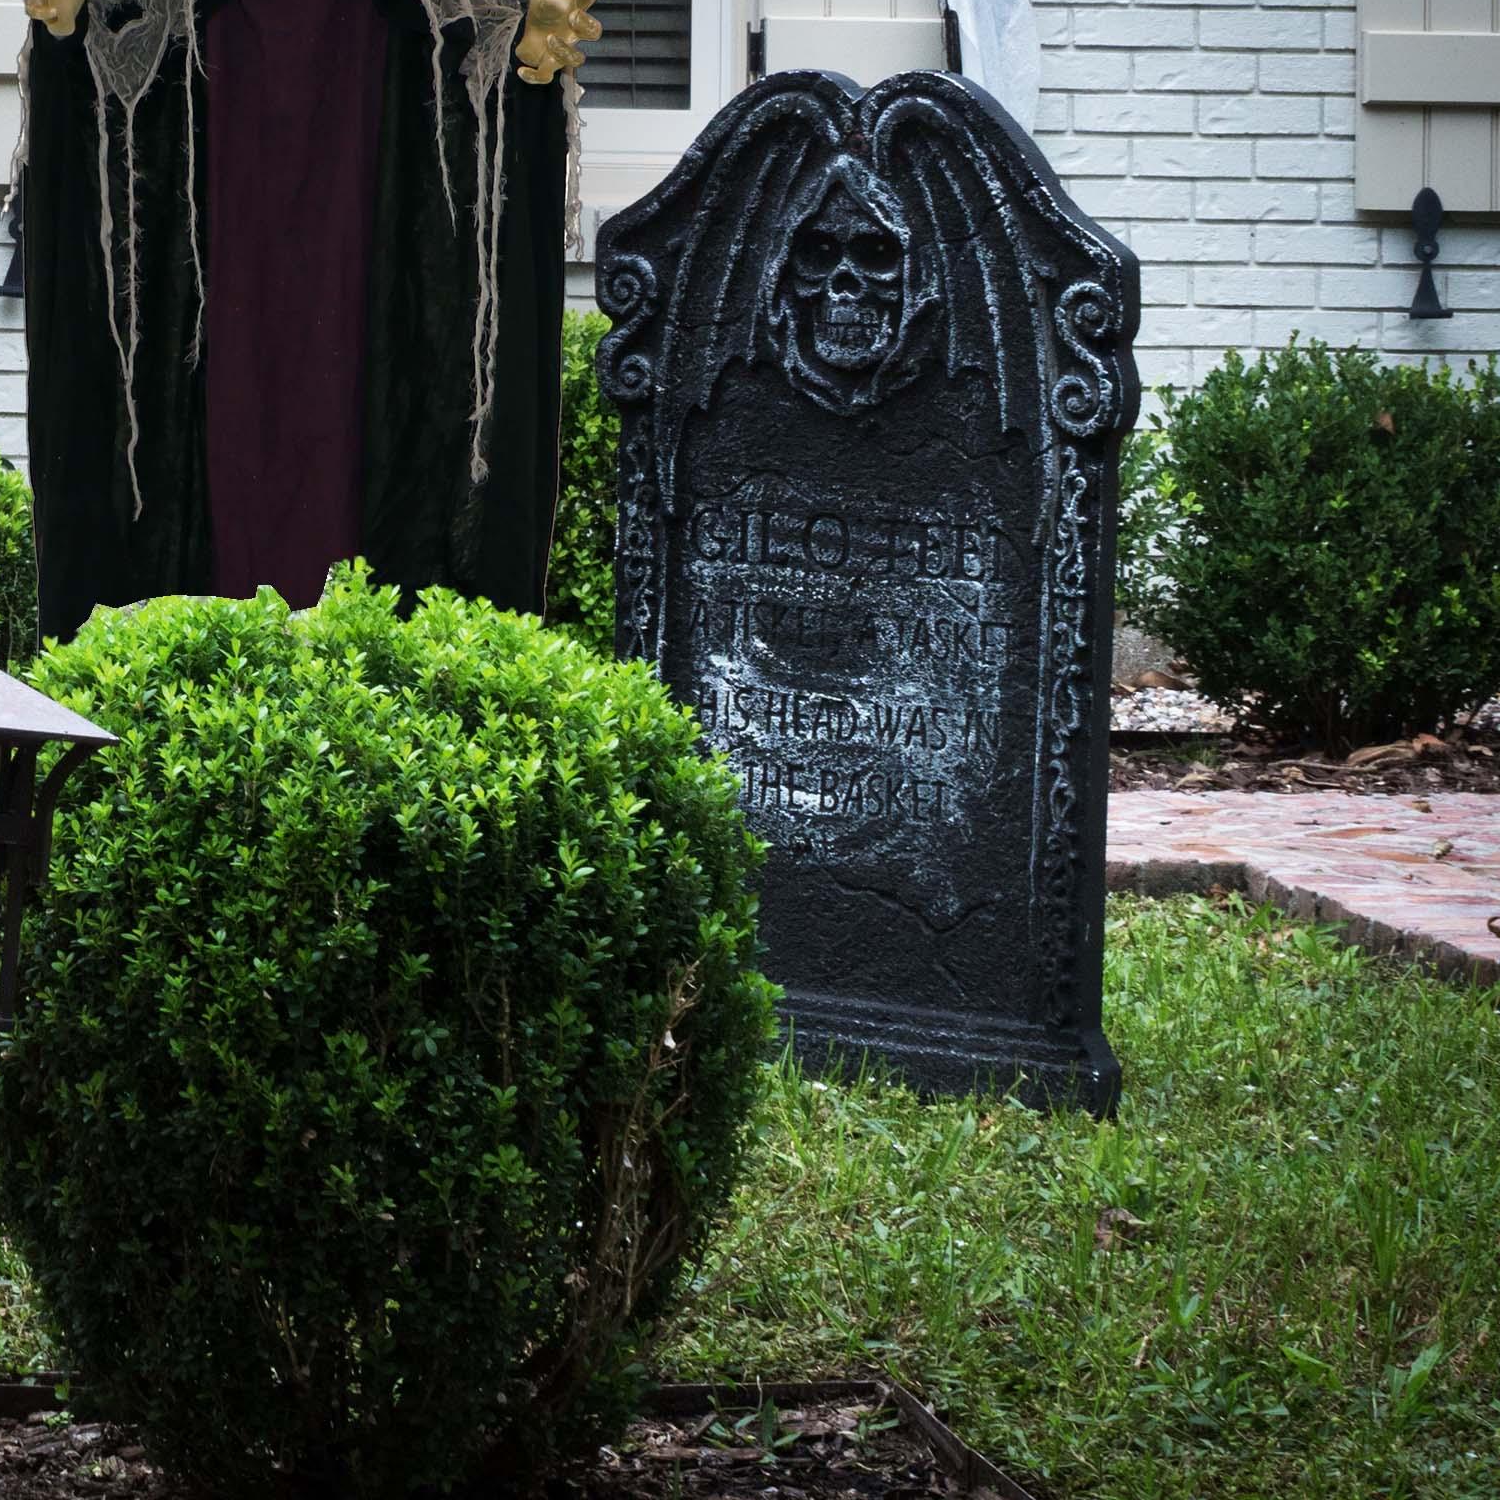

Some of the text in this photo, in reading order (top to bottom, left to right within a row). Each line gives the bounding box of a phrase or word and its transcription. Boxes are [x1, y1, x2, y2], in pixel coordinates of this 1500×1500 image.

[696, 687, 1001, 752] HIS HEAD WAS IN
[742, 760, 948, 821] THE BASKET
